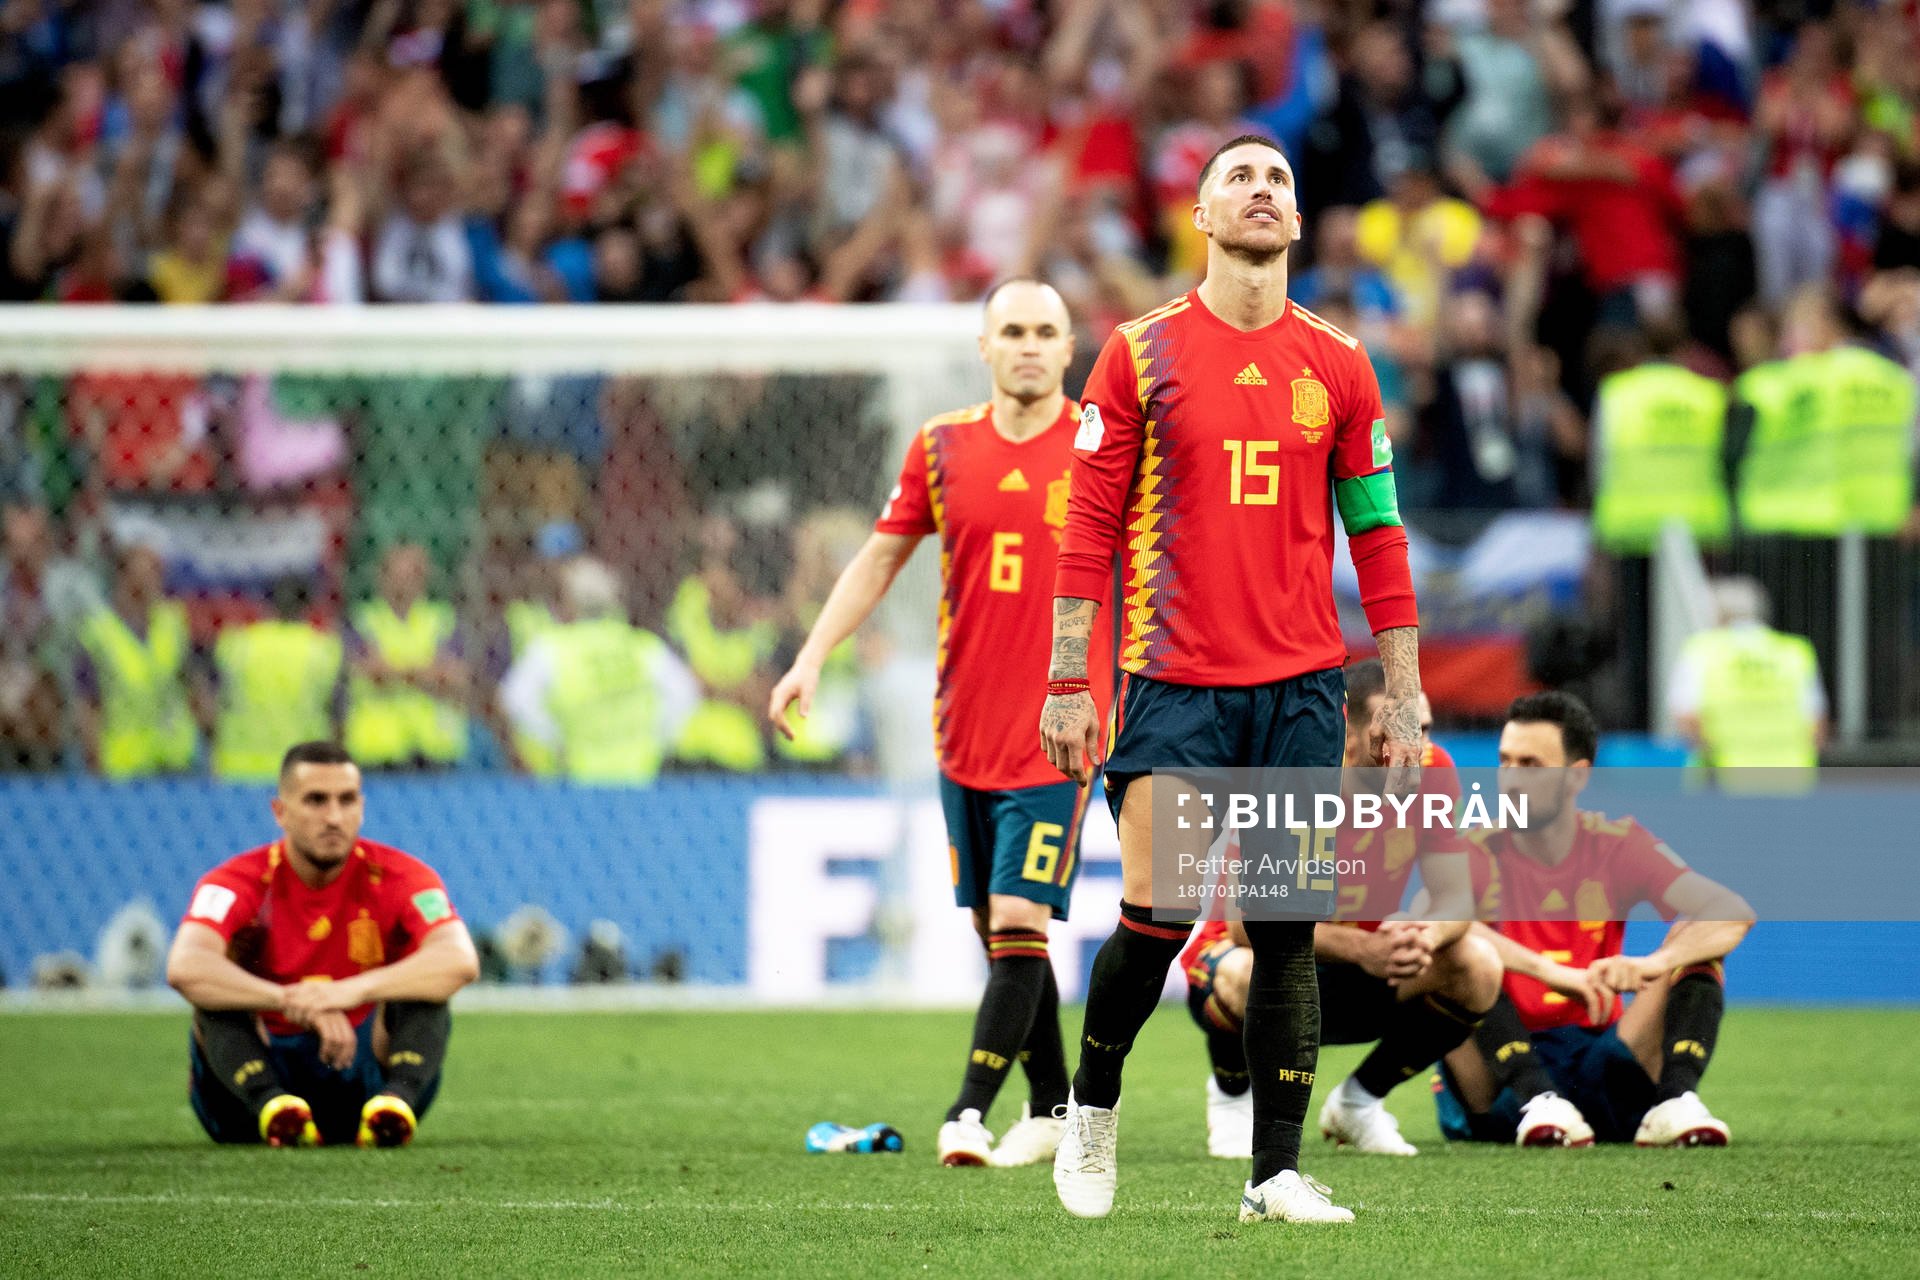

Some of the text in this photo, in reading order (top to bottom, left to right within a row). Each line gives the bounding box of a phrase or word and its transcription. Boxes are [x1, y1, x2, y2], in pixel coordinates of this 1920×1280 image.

[1233, 377, 1268, 386] adidas
[1223, 439, 1280, 505] 15
[989, 532, 1023, 593] 6
[1021, 821, 1064, 884] 6
